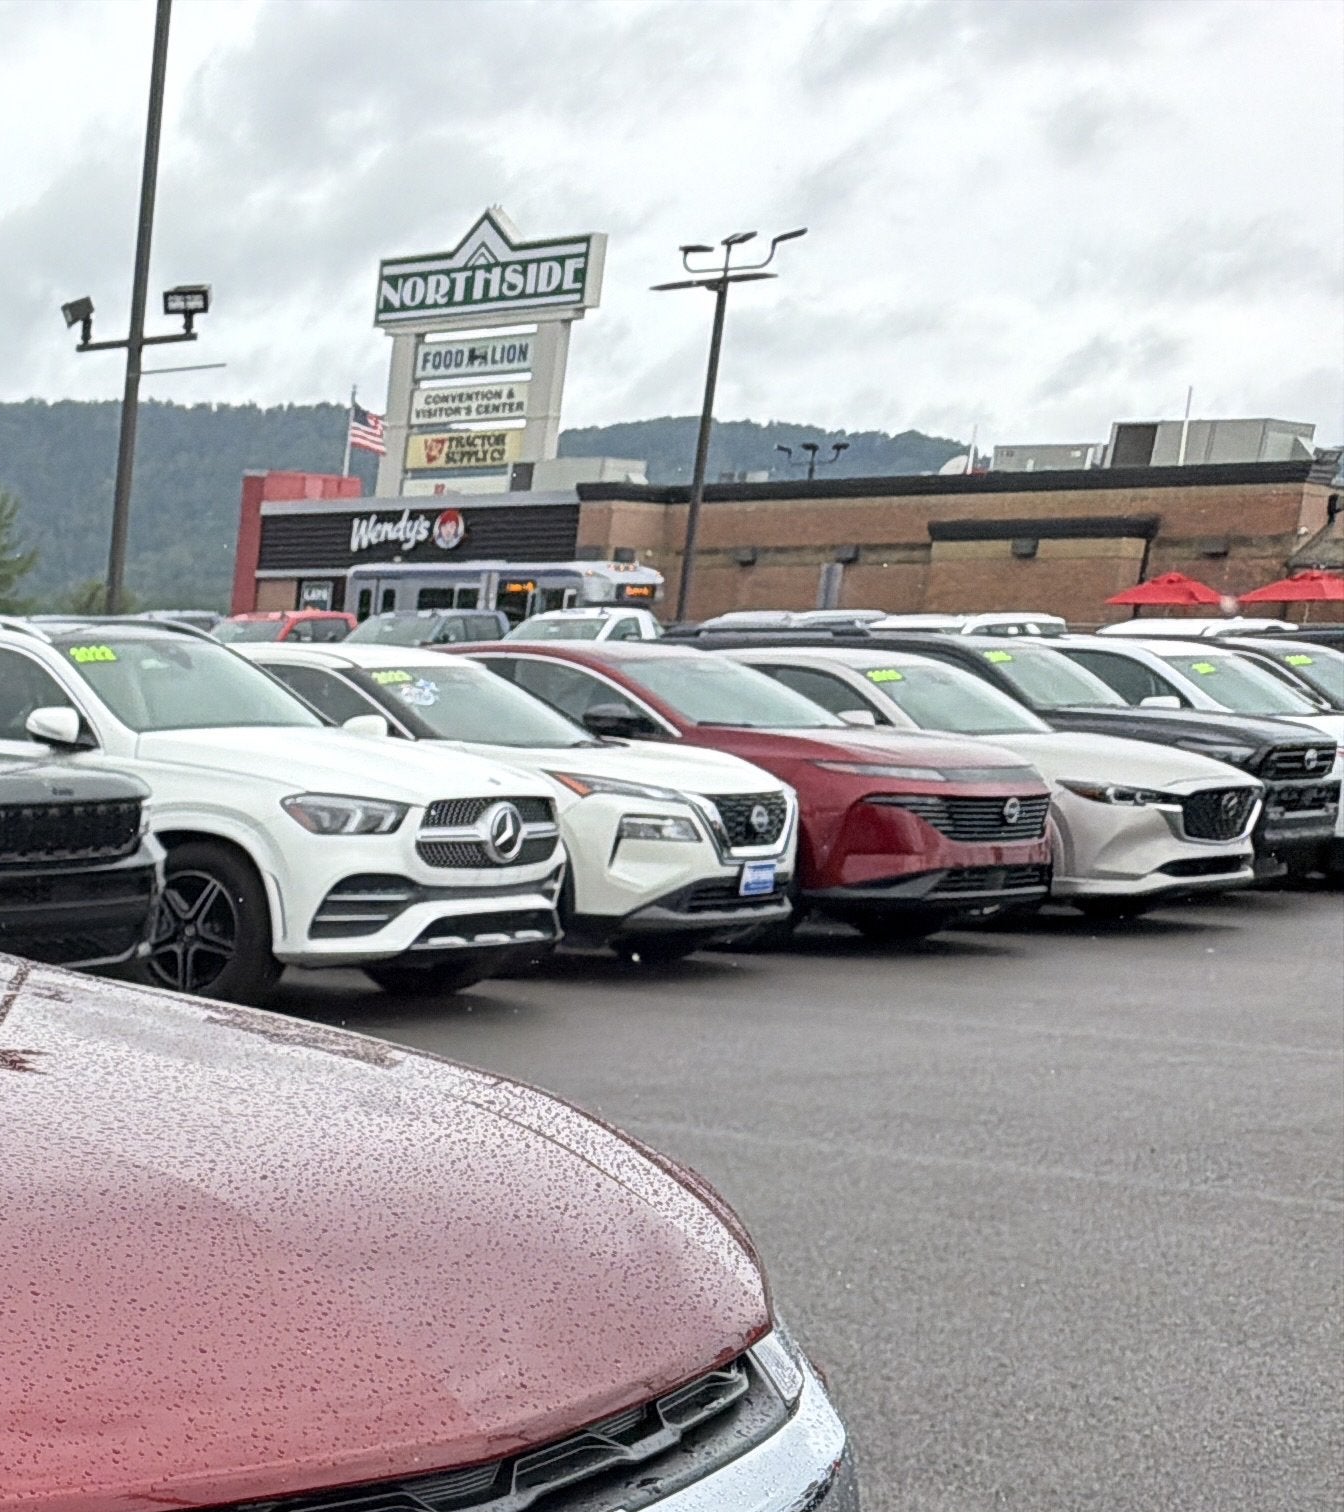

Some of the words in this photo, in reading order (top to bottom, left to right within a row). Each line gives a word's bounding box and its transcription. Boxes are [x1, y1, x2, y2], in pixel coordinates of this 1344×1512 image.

[378, 256, 586, 309] NORTHSIDE
[421, 349, 465, 371] FOOD
[490, 342, 529, 365] LION
[424, 388, 504, 406] CONVENTION
[475, 400, 525, 416] CENTER
[448, 432, 508, 449] TRACTOR
[445, 448, 489, 465] SUPPLY
[351, 508, 431, 553] Wendy's
